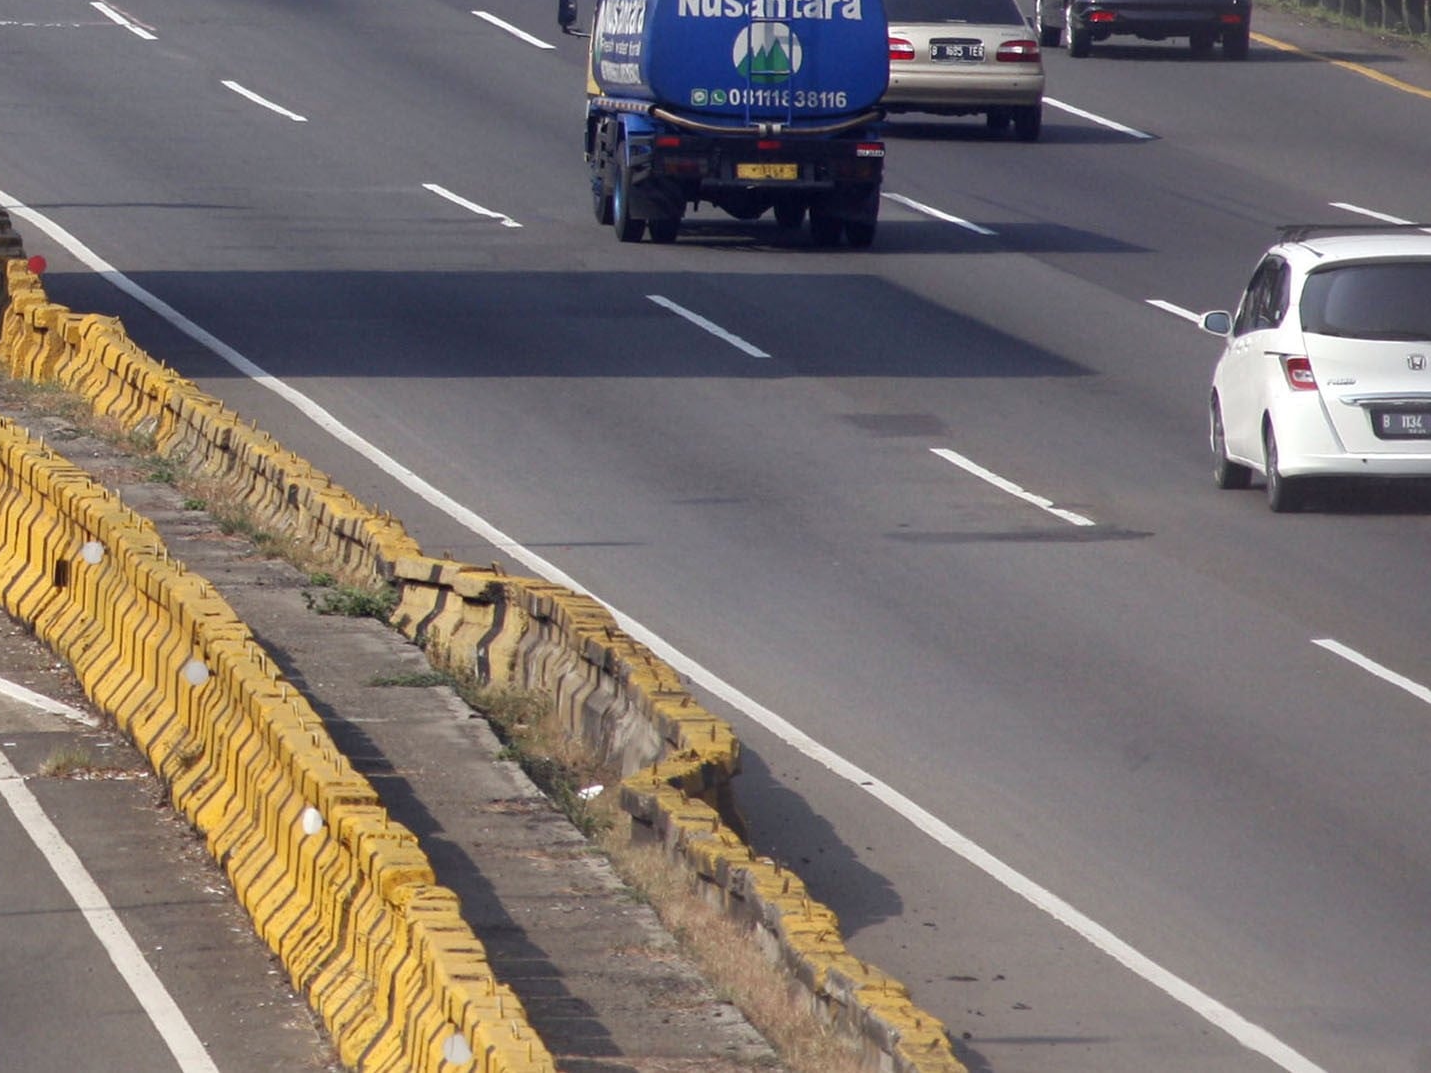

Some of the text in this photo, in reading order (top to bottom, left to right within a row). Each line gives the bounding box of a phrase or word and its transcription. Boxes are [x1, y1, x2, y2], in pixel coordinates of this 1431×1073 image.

[969, 46, 984, 57] TER
[1382, 414, 1422, 428] B 1134
